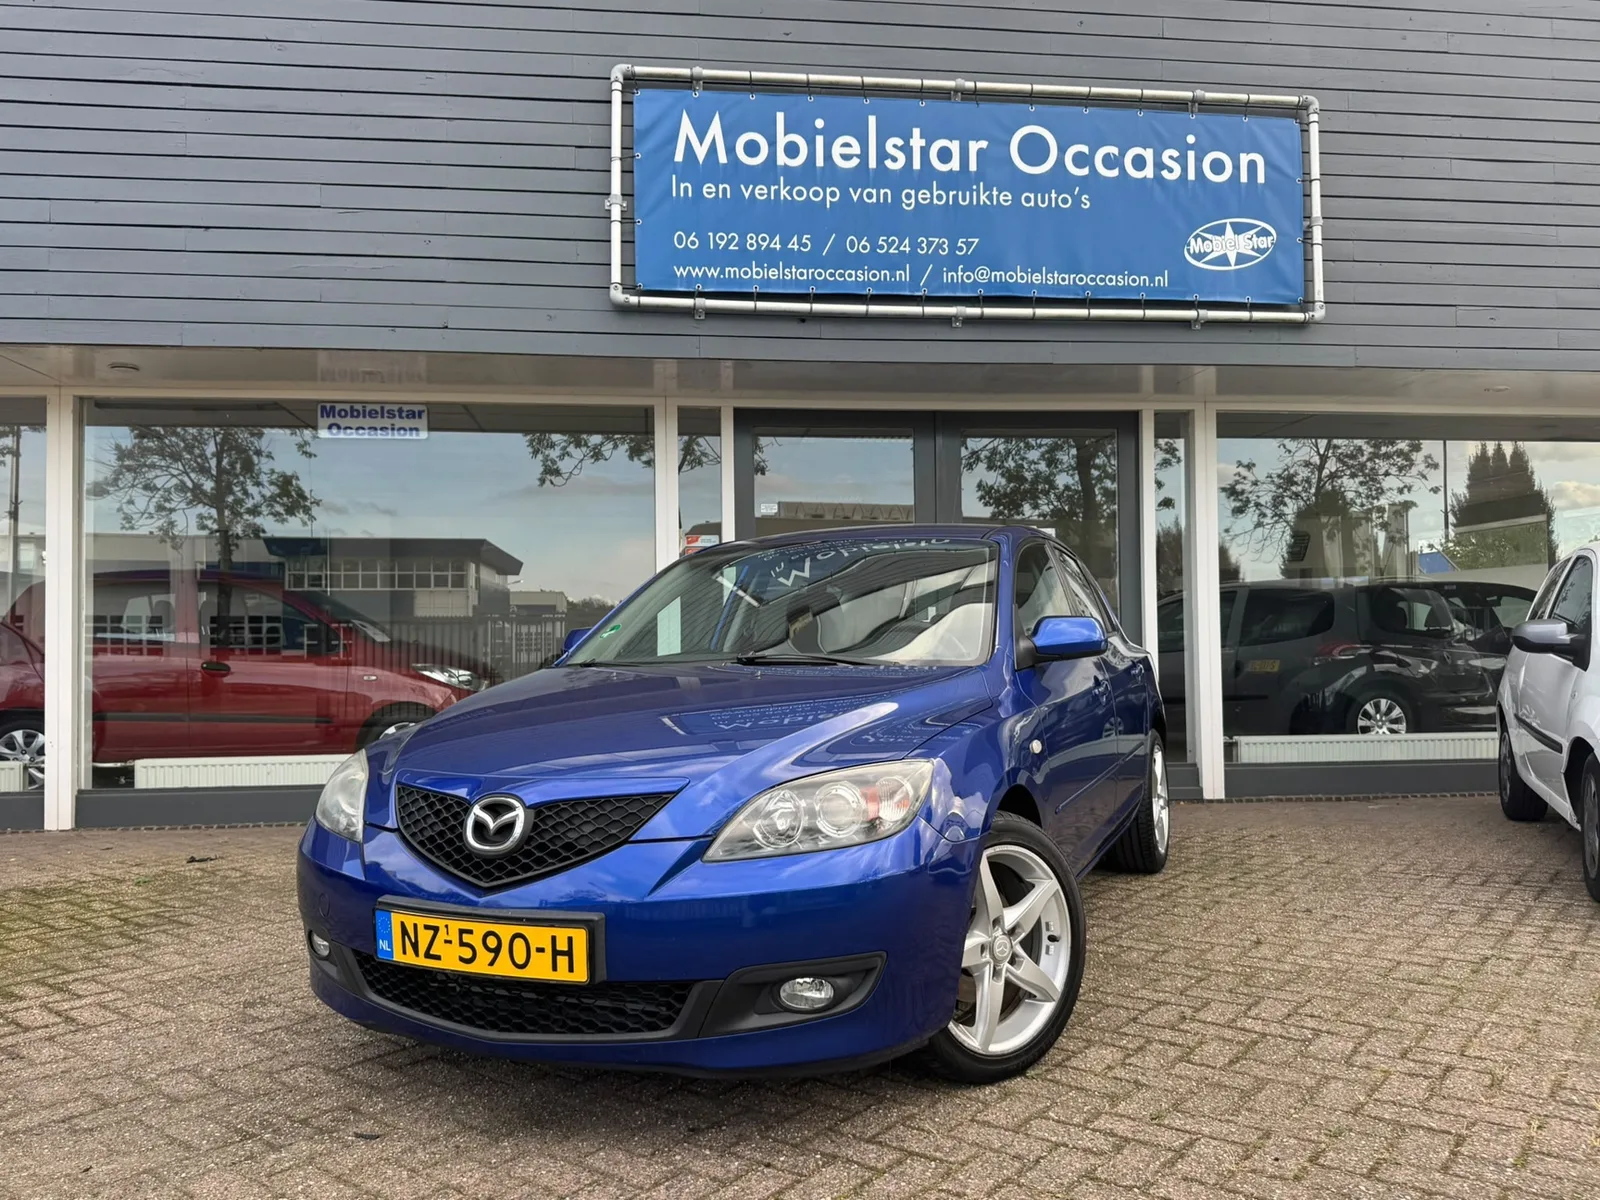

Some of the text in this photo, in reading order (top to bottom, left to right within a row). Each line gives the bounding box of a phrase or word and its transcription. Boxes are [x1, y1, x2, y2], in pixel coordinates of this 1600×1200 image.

[673, 109, 1266, 184] Mobielstar Occasion
[672, 174, 1091, 211] In en verkoop van gebruikte auto's
[673, 231, 980, 256] 06 192 894 45 / 06 524 373 57
[1187, 233, 1275, 255] Mobiel Star
[673, 260, 1168, 287] www.mobielstaroccasion.nl / info@mobielstaroccasion.nl
[320, 405, 425, 419] Mobielstar
[327, 423, 420, 437] Occasion
[379, 939, 391, 951] NL
